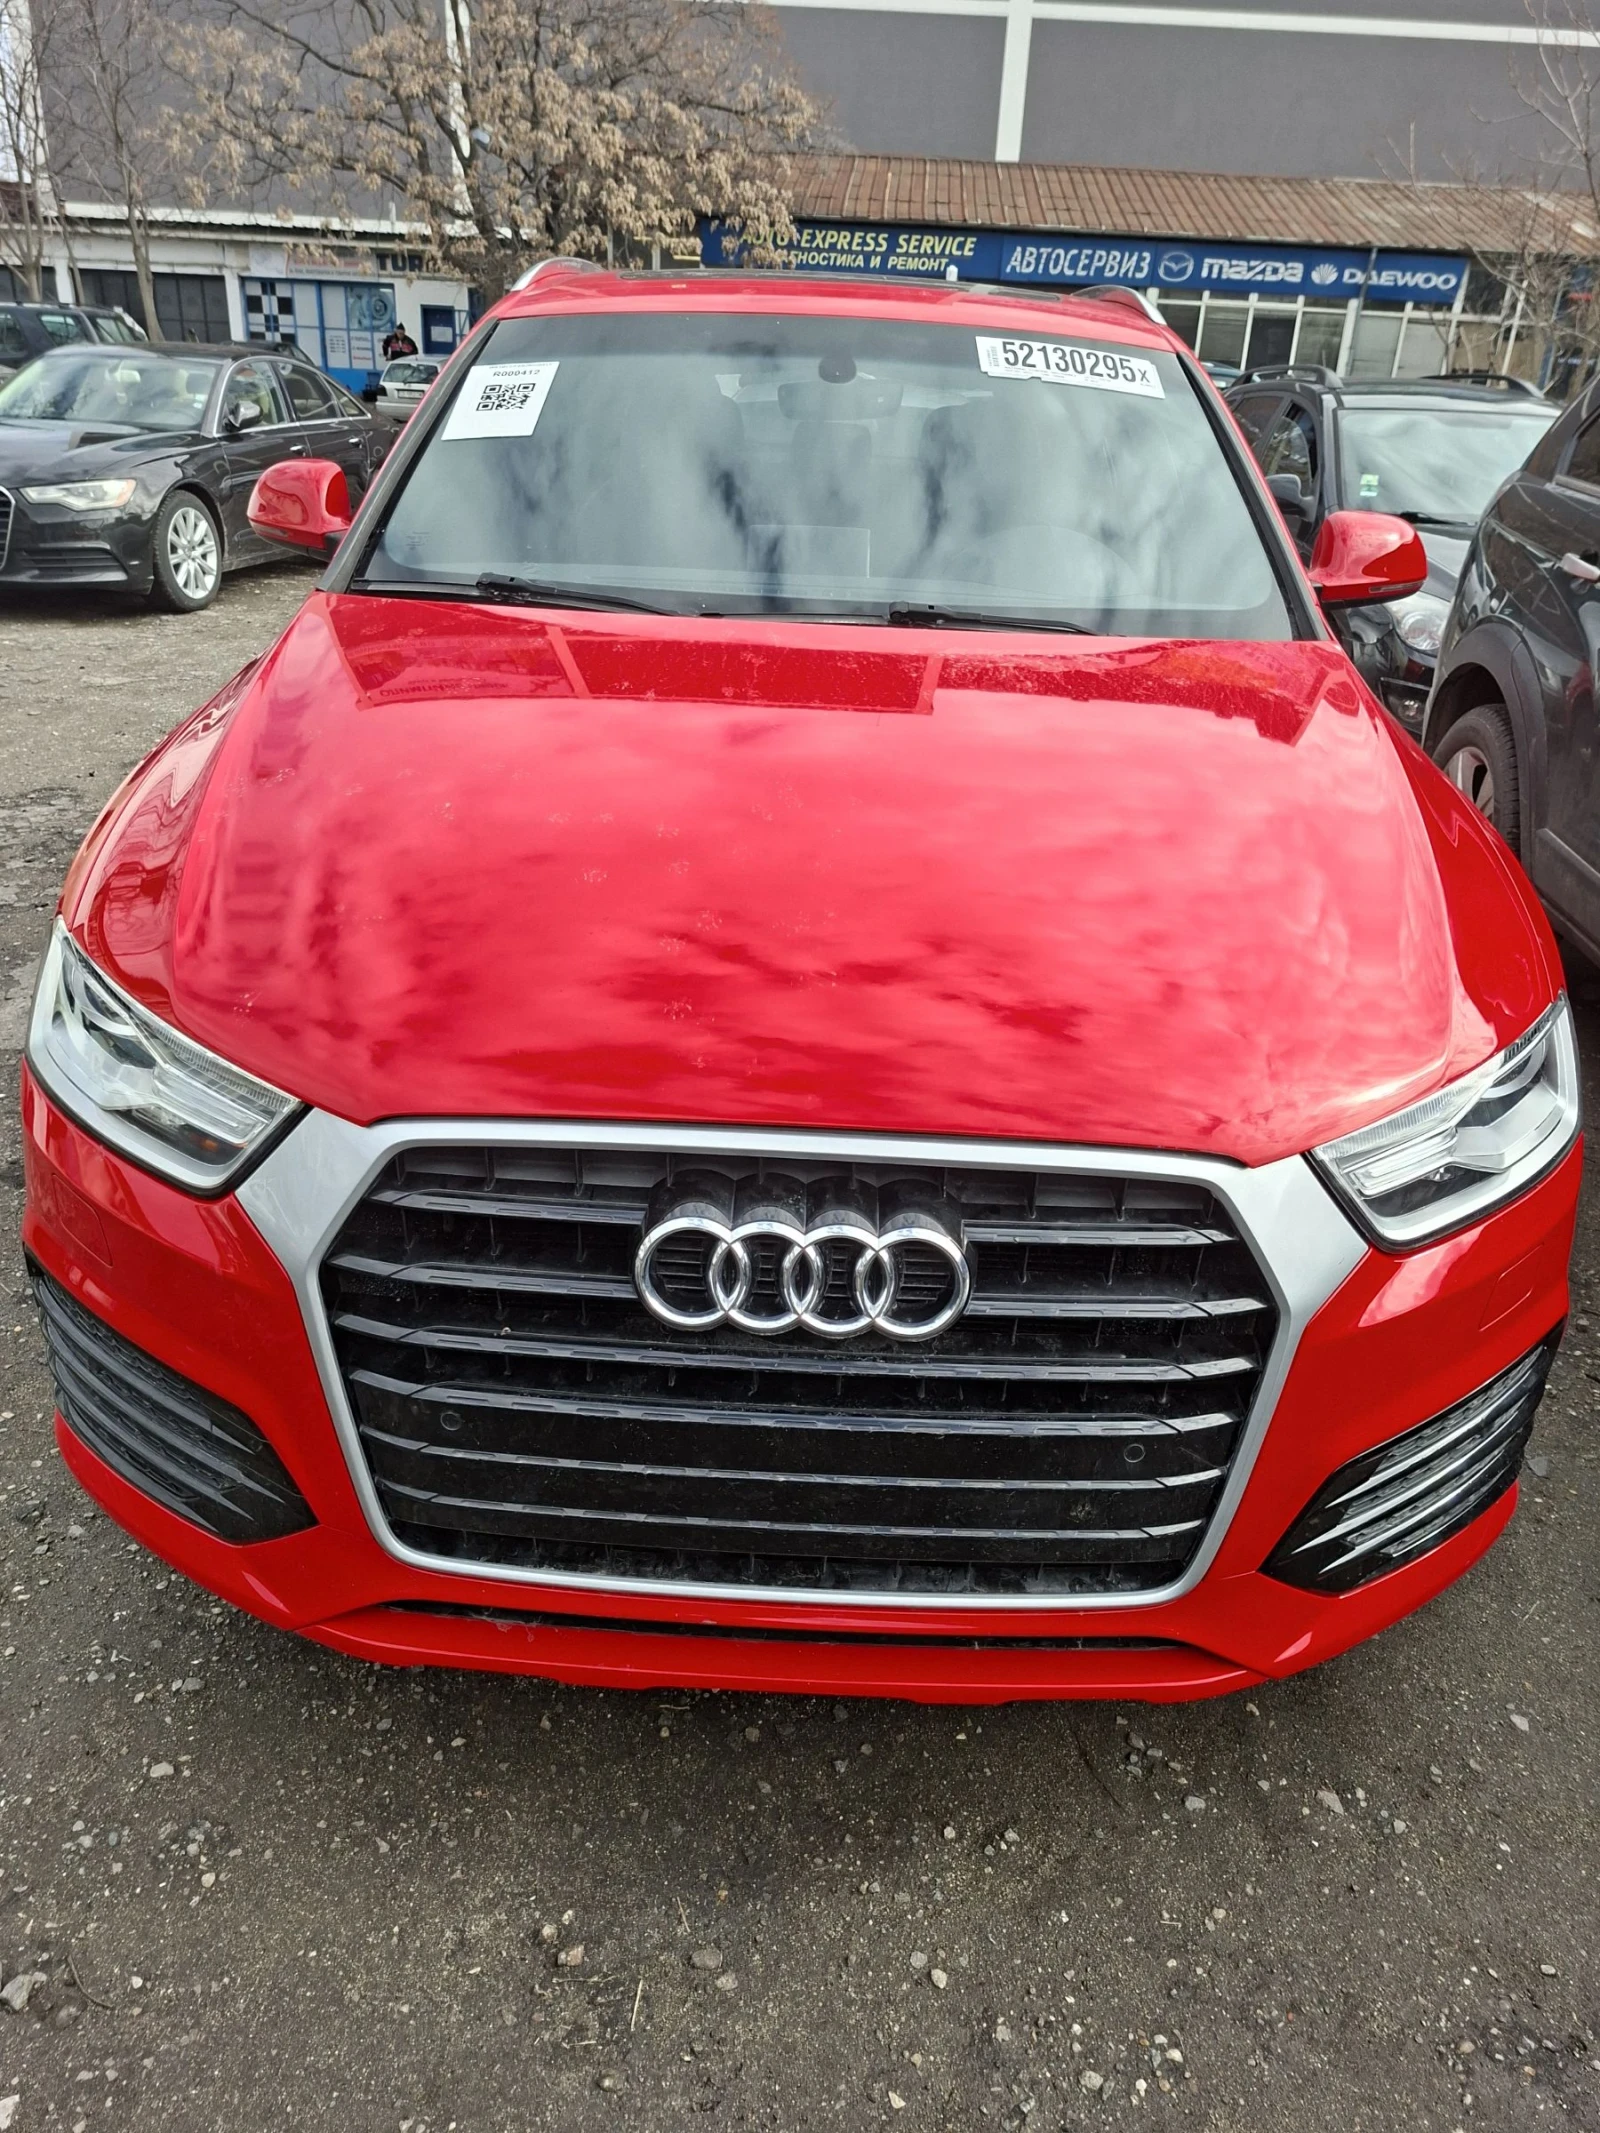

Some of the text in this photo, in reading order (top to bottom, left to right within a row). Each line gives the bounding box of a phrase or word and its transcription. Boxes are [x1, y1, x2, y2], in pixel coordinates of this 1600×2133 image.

[800, 229, 888, 252] EXPRESS
[896, 234, 977, 256] SERVICE
[869, 256, 881, 269] И
[887, 256, 949, 272] РЕМОНТ
[1006, 246, 1152, 279] АВТОСЕРВИЗ
[1342, 268, 1458, 291] DAEWOO
[493, 369, 541, 377] R000412
